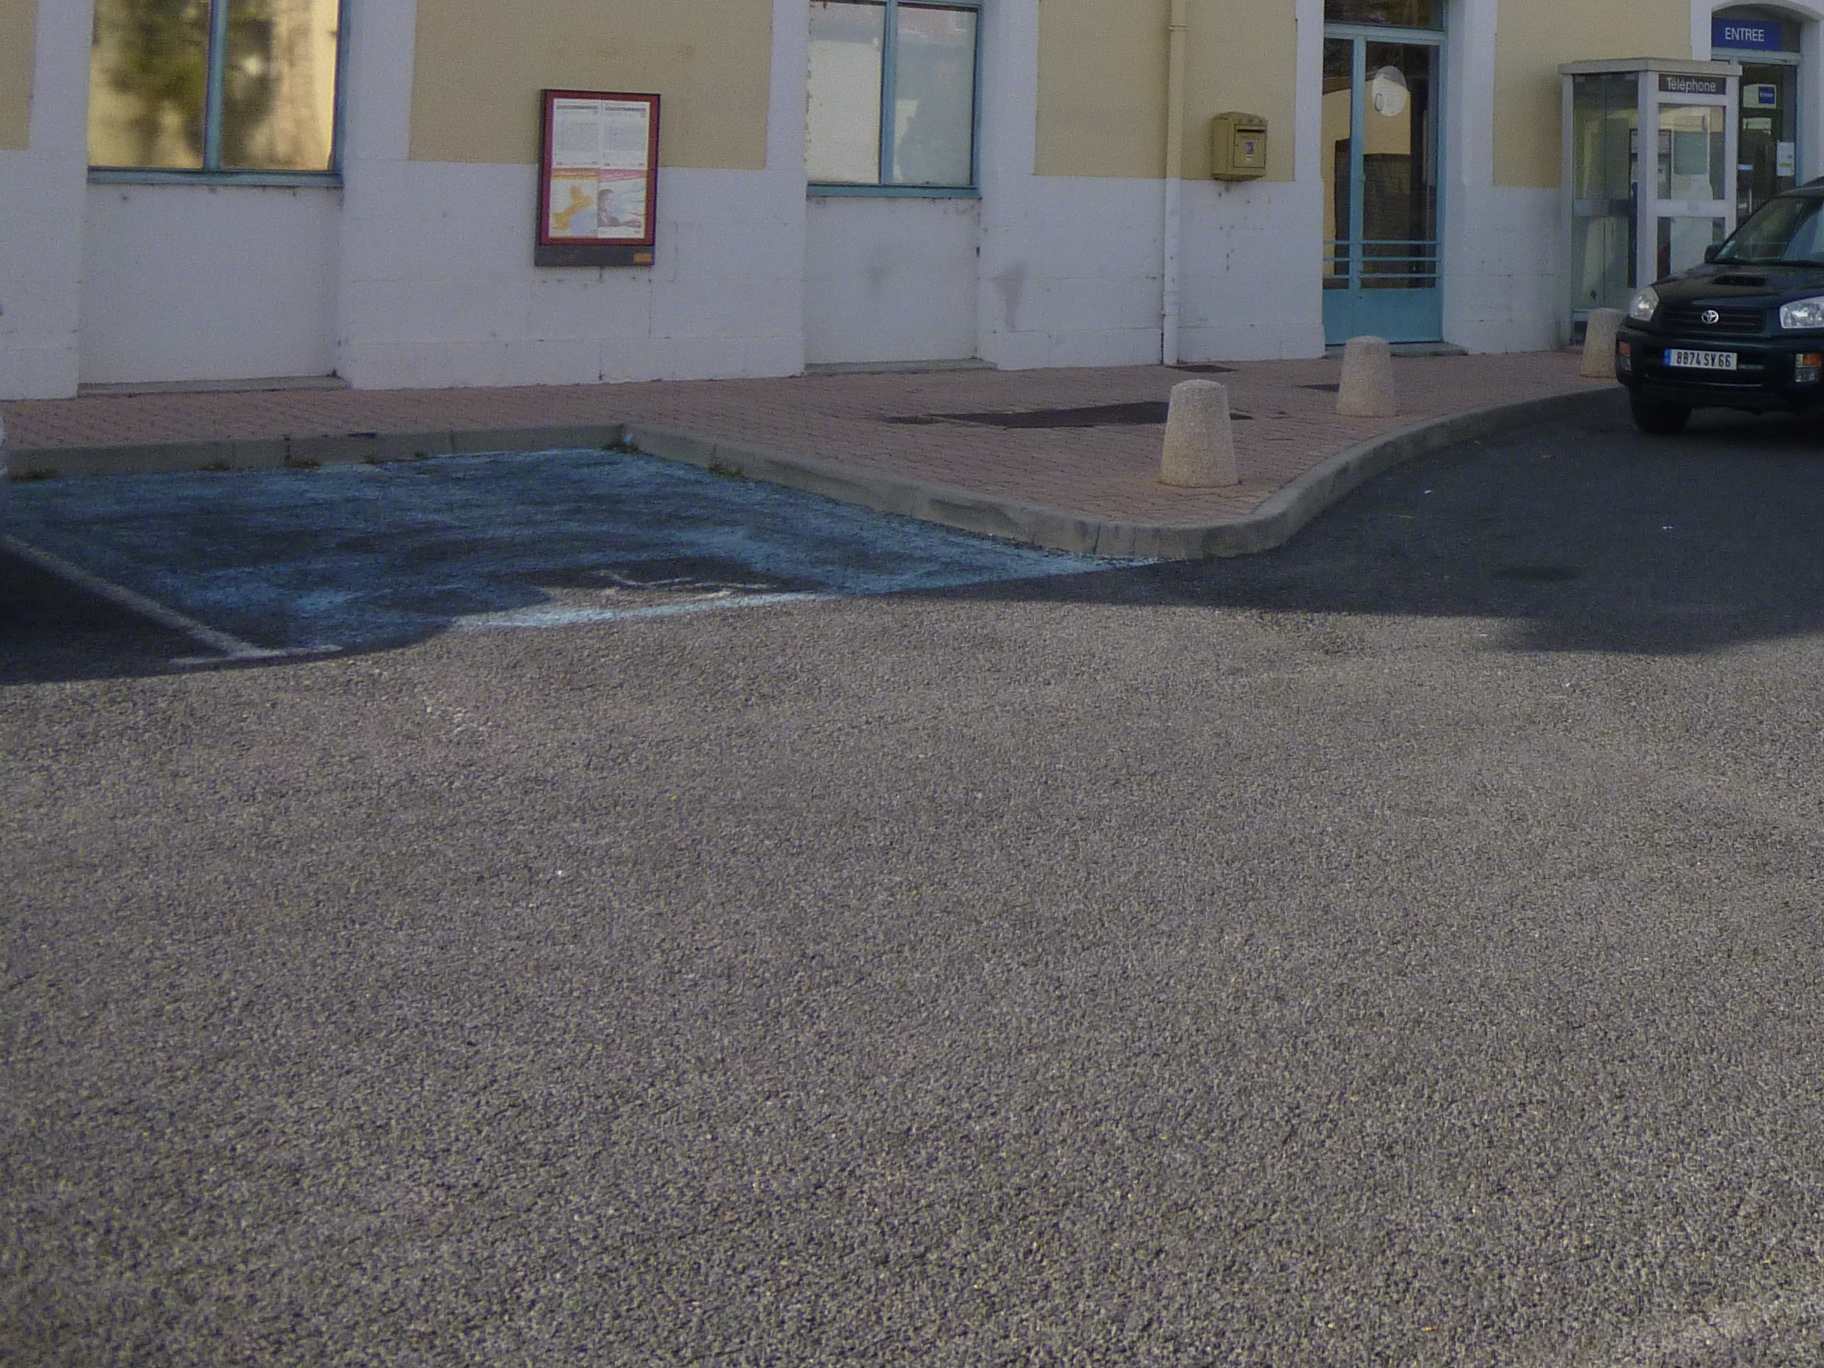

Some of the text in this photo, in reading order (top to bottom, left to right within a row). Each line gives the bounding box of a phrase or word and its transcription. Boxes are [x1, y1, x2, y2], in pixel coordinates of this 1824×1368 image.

[1725, 27, 1765, 42] ENTREE
[1666, 76, 1717, 93] Téléphone
[1676, 352, 1702, 365] 8874
[1718, 354, 1731, 367] 66
